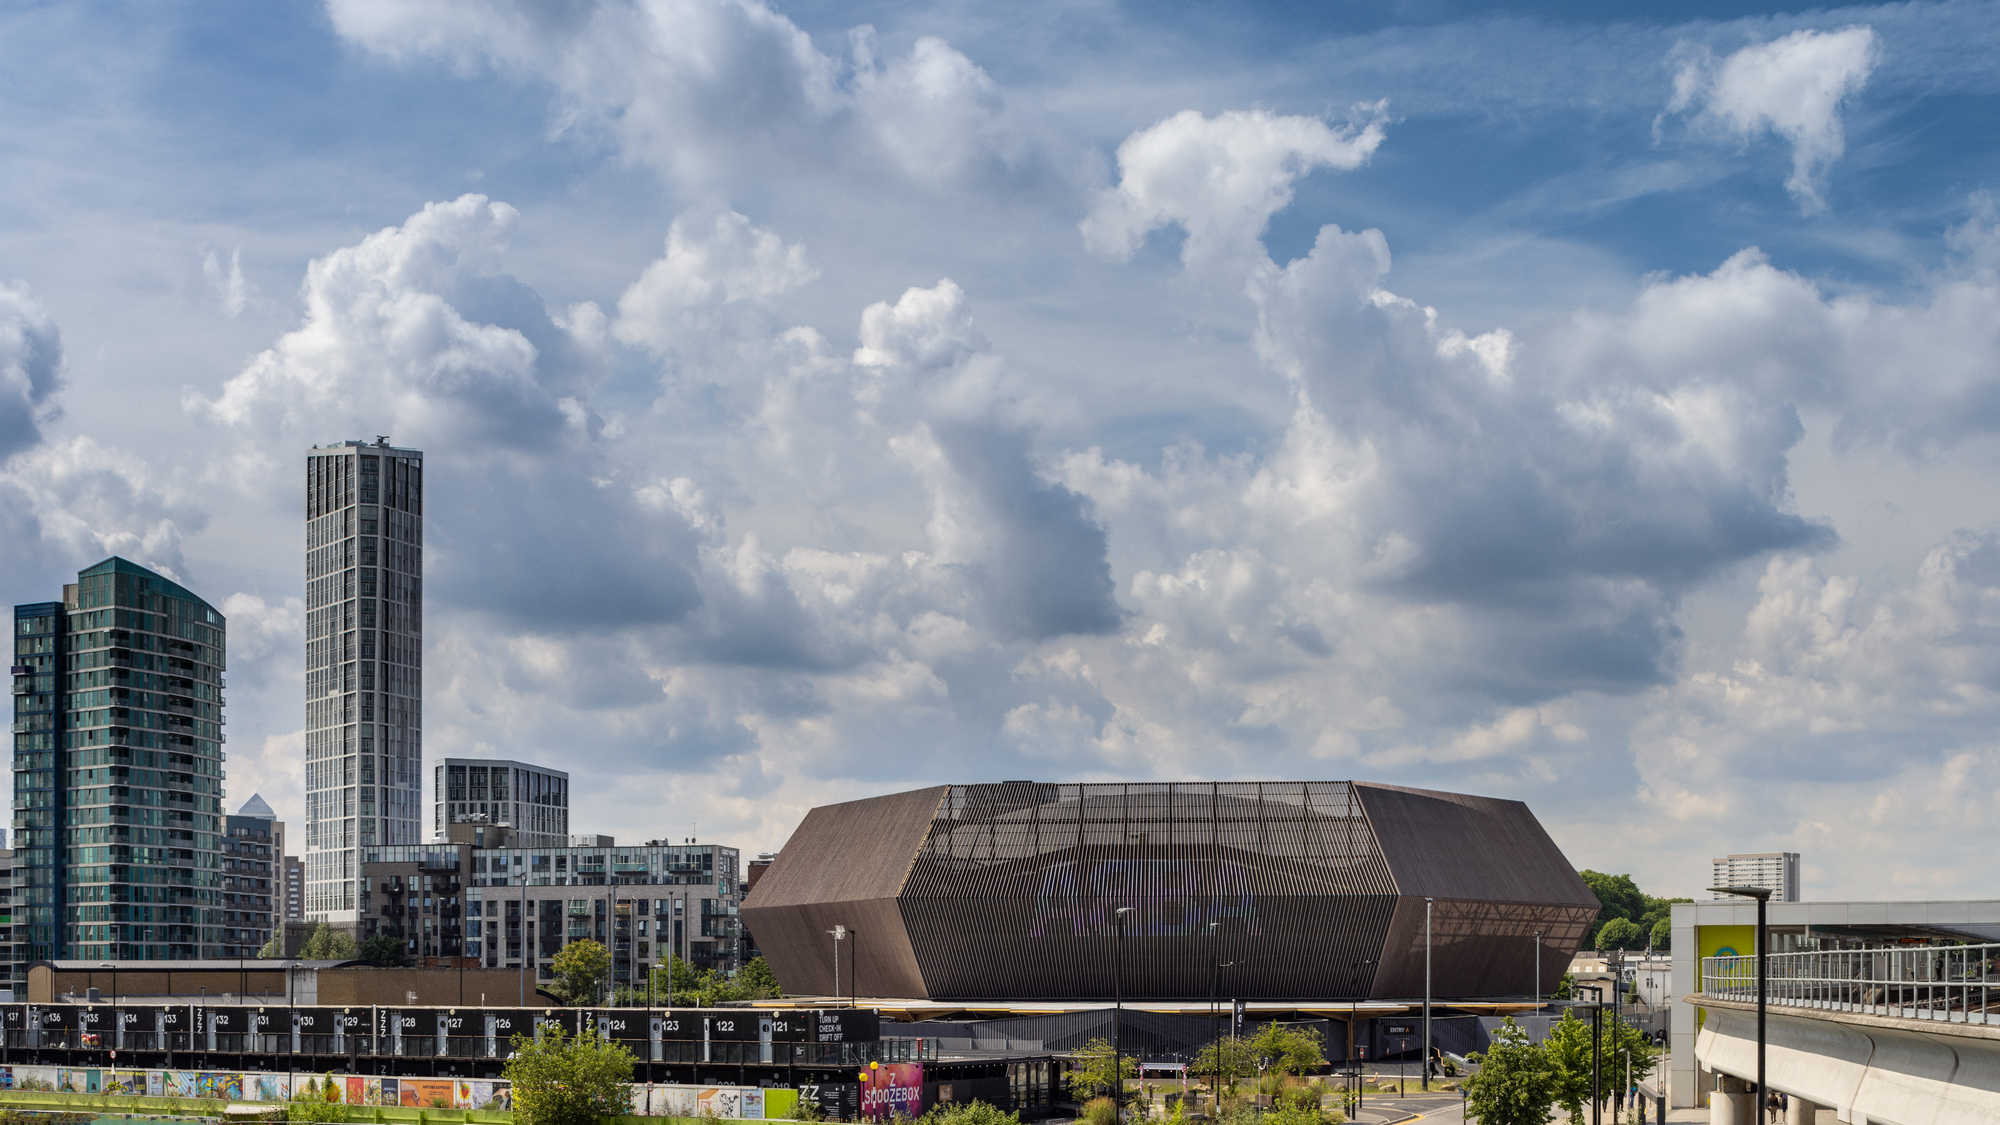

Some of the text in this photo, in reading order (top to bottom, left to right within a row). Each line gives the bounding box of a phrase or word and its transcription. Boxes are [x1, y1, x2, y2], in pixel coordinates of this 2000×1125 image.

[8, 1012, 18, 1021] 137
[48, 1013, 60, 1022] 136
[86, 1014, 98, 1022] 135
[124, 1014, 137, 1023] 134
[164, 1014, 176, 1023] 133
[216, 1015, 228, 1024] 132
[258, 1016, 269, 1025] 131
[300, 1016, 314, 1026] 130
[344, 1016, 358, 1026] 129
[401, 1018, 416, 1027] 128
[448, 1018, 462, 1028] 127
[496, 1018, 510, 1028] 126
[544, 1020, 560, 1029] 125
[610, 1020, 626, 1030] 124
[662, 1020, 678, 1030] 123
[716, 1020, 734, 1032] 122
[772, 1022, 788, 1032] 121
[864, 1086, 920, 1104] SNOOZEBOX
